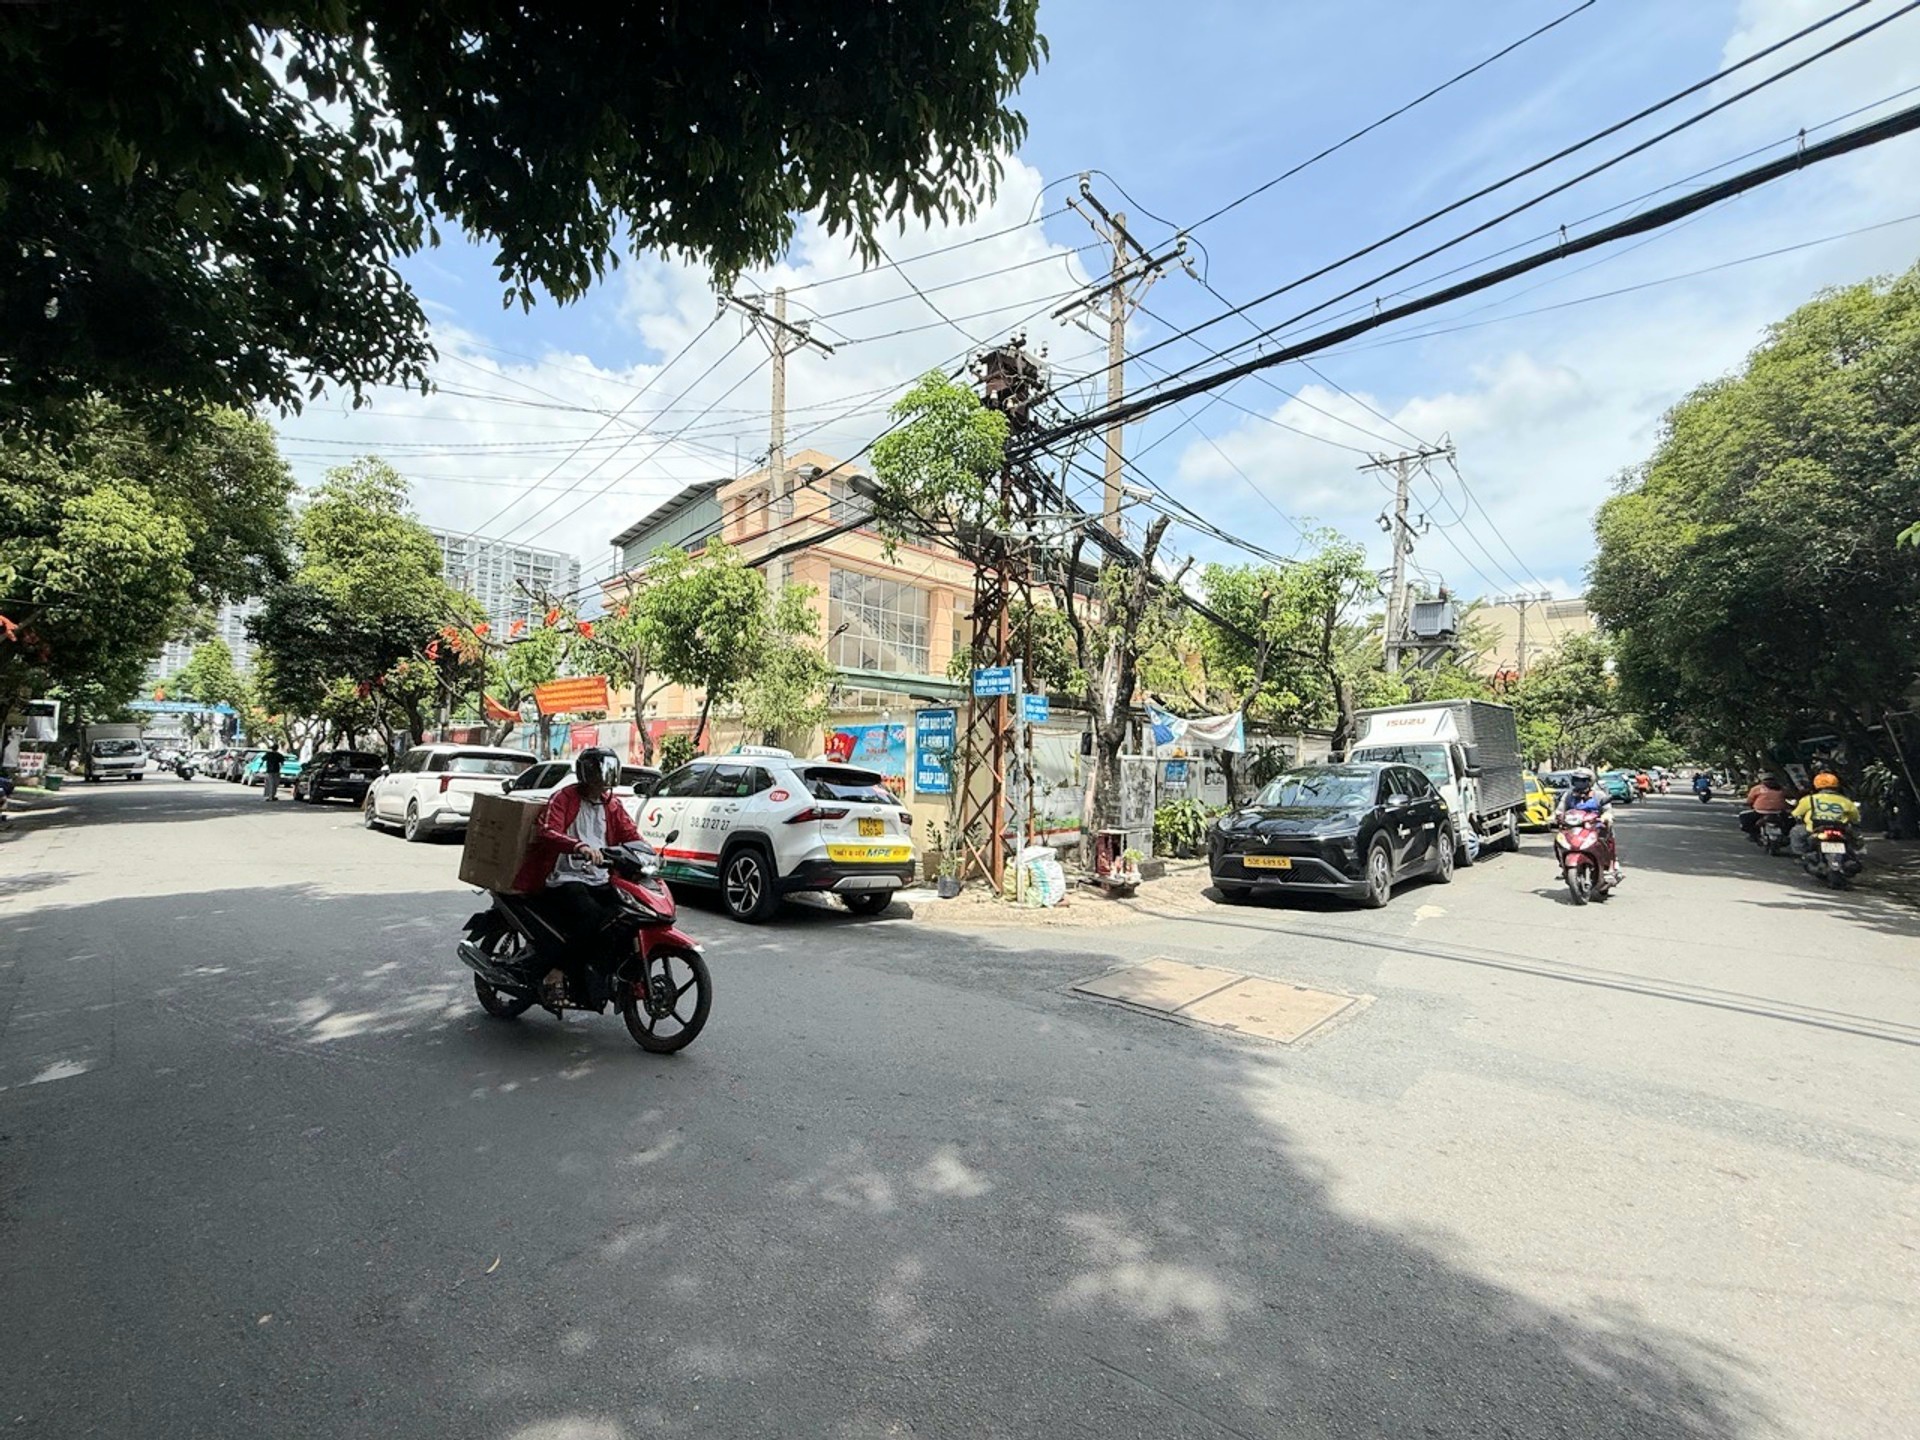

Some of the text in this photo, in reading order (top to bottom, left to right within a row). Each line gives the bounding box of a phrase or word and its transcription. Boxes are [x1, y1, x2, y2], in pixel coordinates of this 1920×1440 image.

[1387, 718, 1426, 727] ISUZU
[1816, 799, 1844, 813] be
[866, 848, 891, 858] MPE
